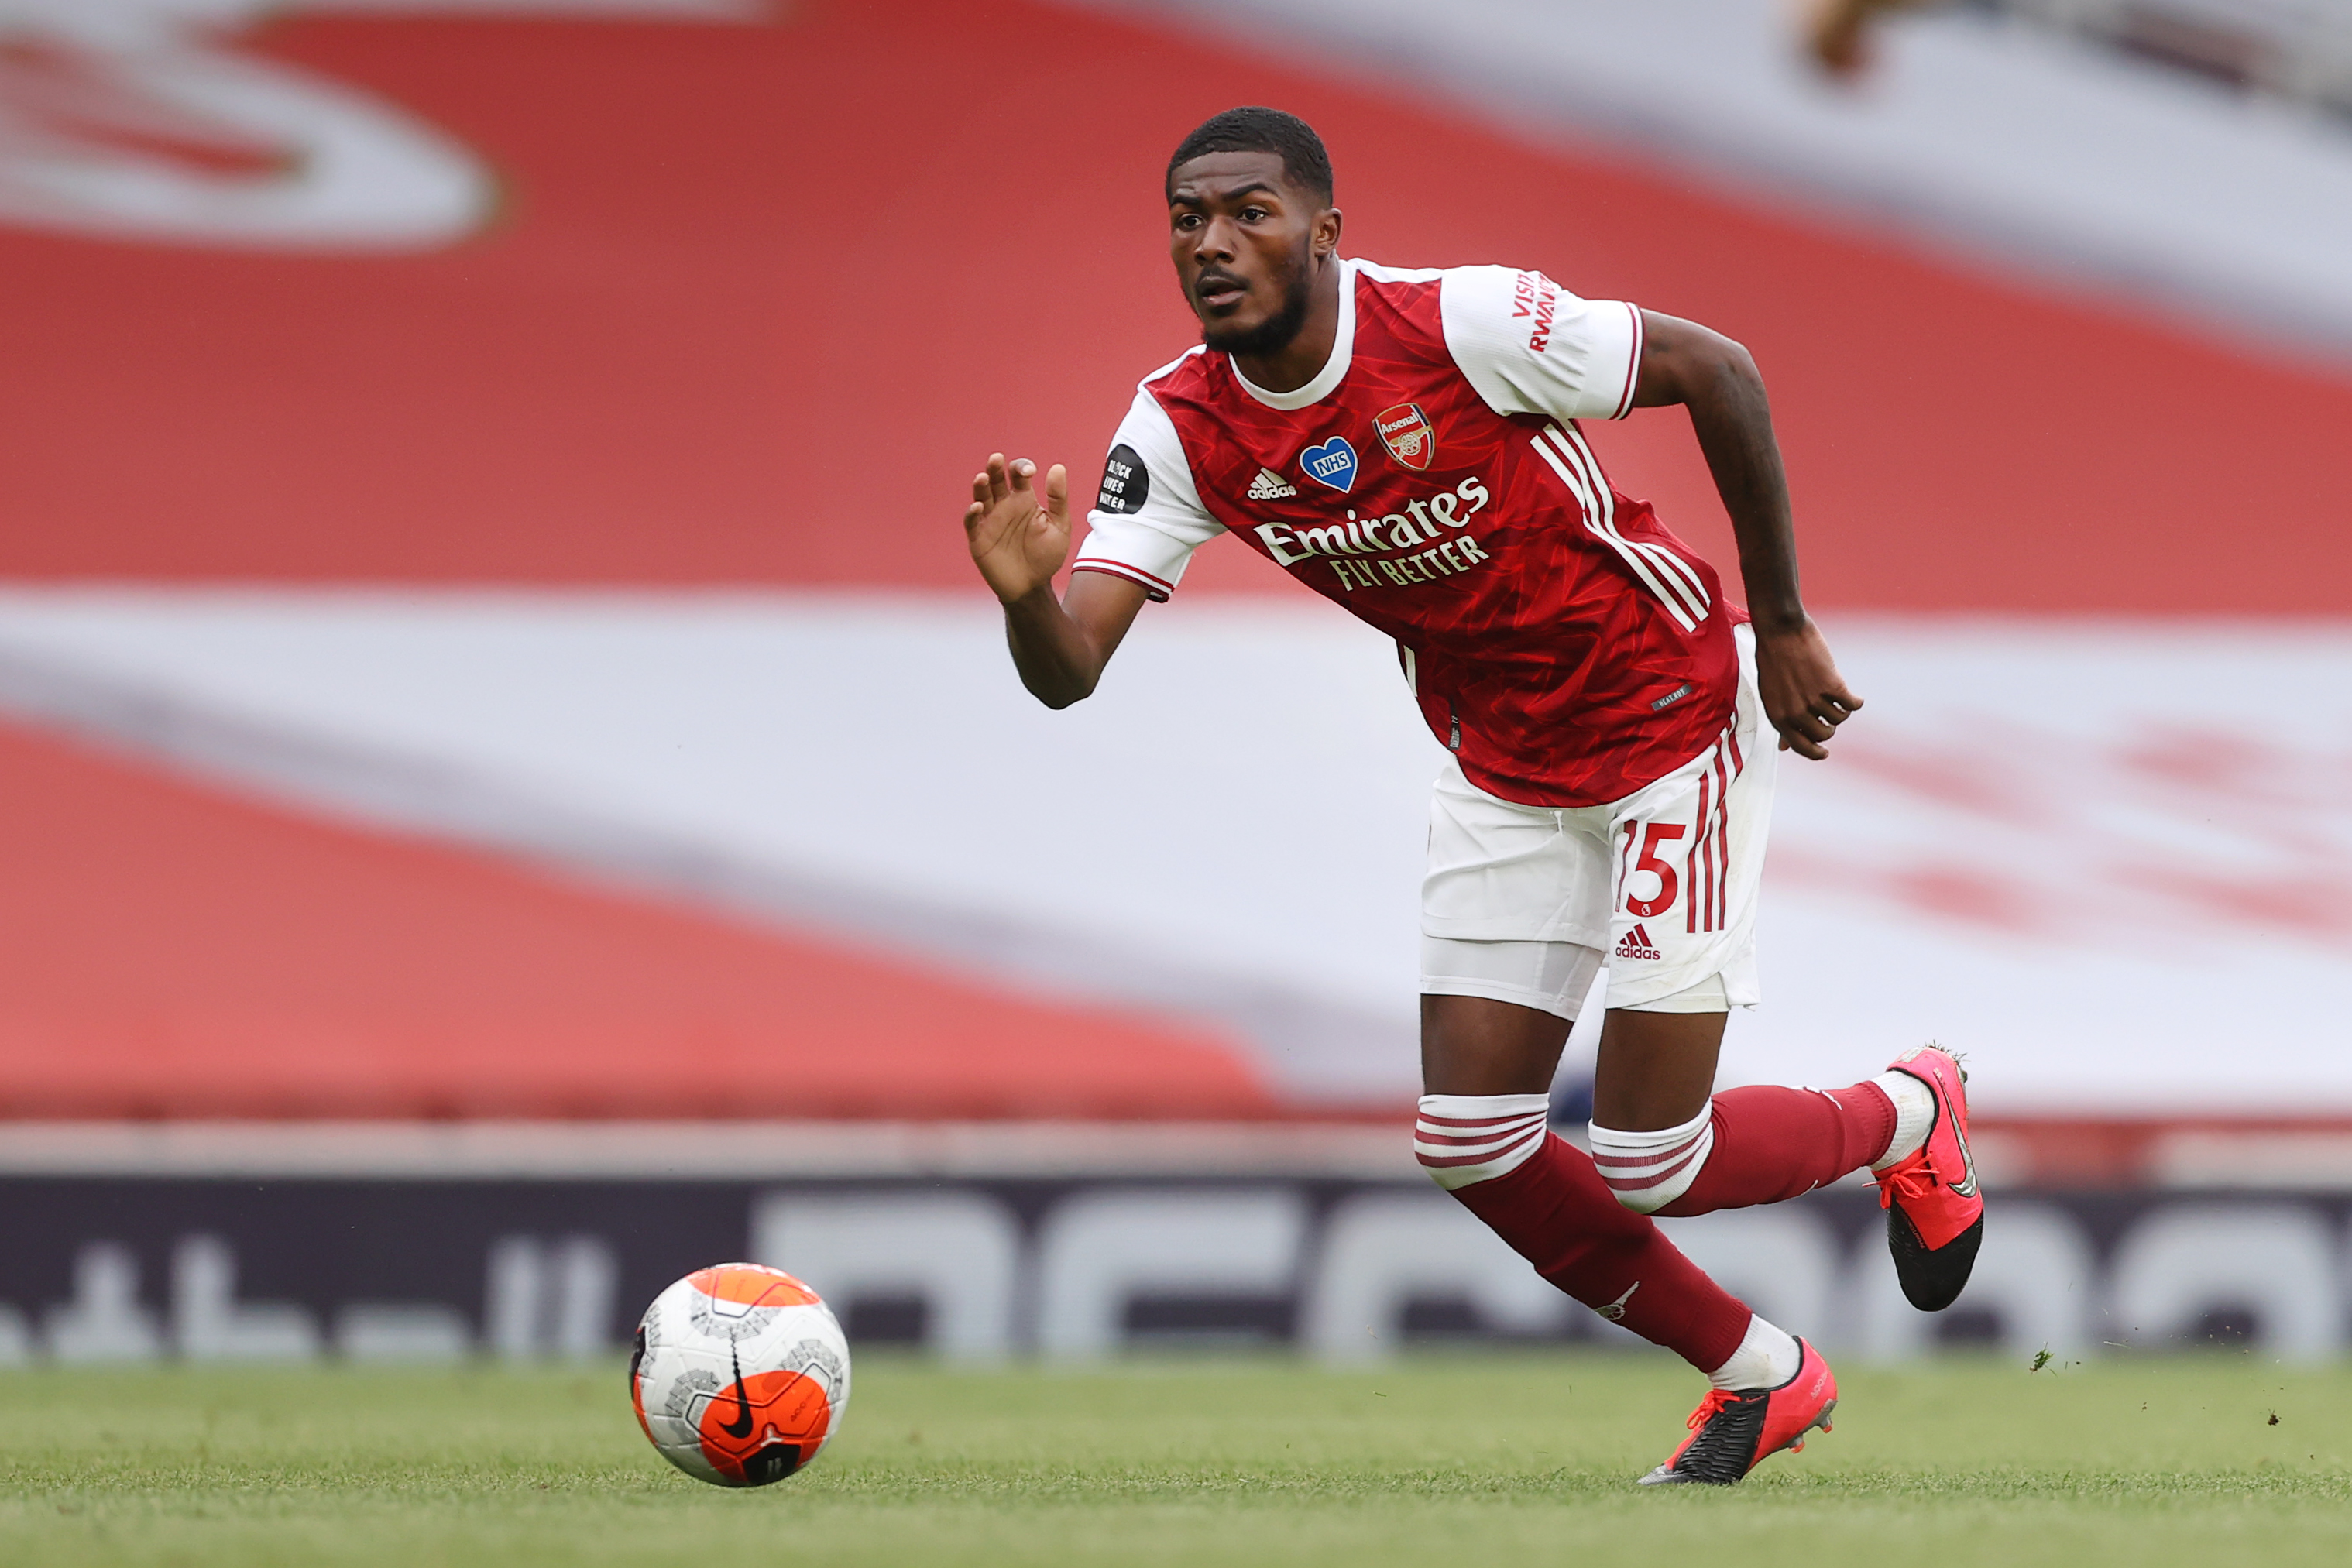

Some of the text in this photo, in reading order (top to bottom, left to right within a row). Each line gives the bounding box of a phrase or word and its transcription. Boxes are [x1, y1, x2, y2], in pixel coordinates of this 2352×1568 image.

[1512, 273, 1535, 317] VISIT
[1381, 412, 1419, 435] Arsenal
[1317, 451, 1349, 475] NHS
[1103, 476, 1125, 494] LIVES
[1247, 485, 1297, 499] adidas
[1253, 475, 1489, 567] Emirates
[1331, 535, 1489, 591] FLY BETTER
[1615, 945, 1661, 960] adidas
